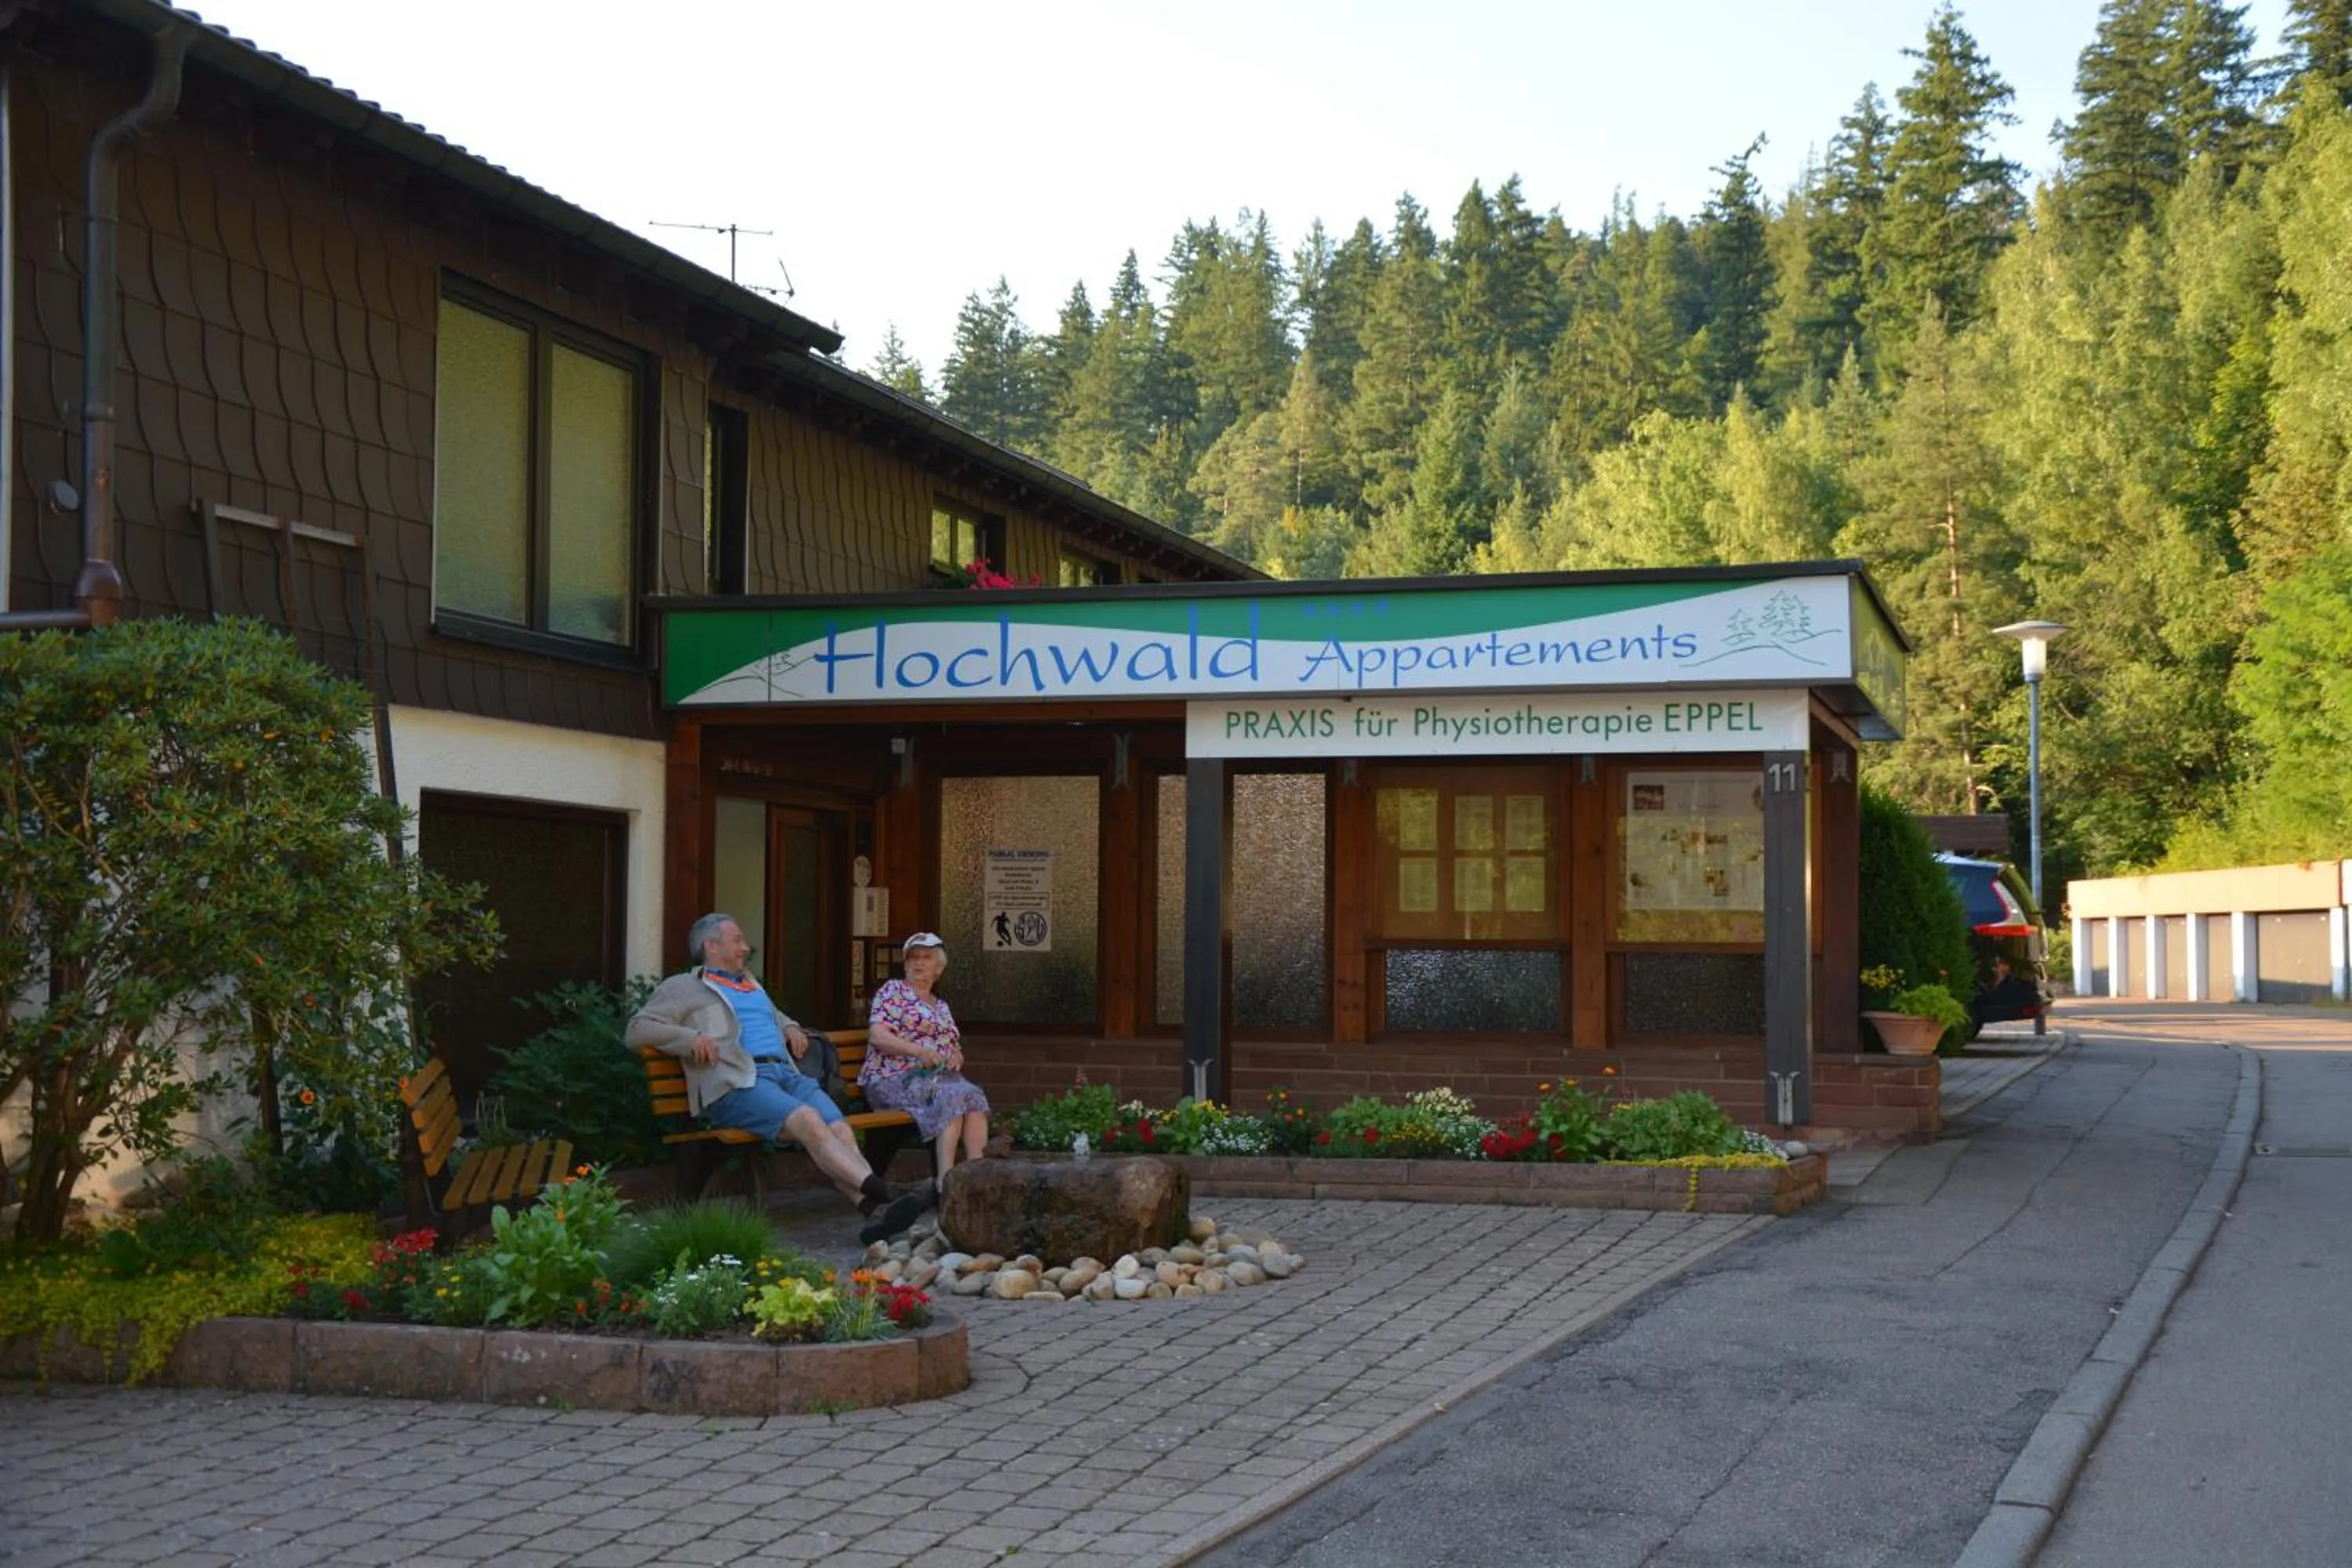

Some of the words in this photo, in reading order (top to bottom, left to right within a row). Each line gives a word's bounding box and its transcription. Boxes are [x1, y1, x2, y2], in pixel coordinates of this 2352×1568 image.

[815, 601, 1259, 693] Hochwald
[1298, 623, 1697, 688] Appartements
[1225, 708, 1335, 739] PRAXIS
[1354, 707, 1399, 737] für
[1413, 704, 1653, 742] Physiotherapie
[1663, 702, 1763, 732] EPPEL
[1768, 763, 1796, 793] 11
